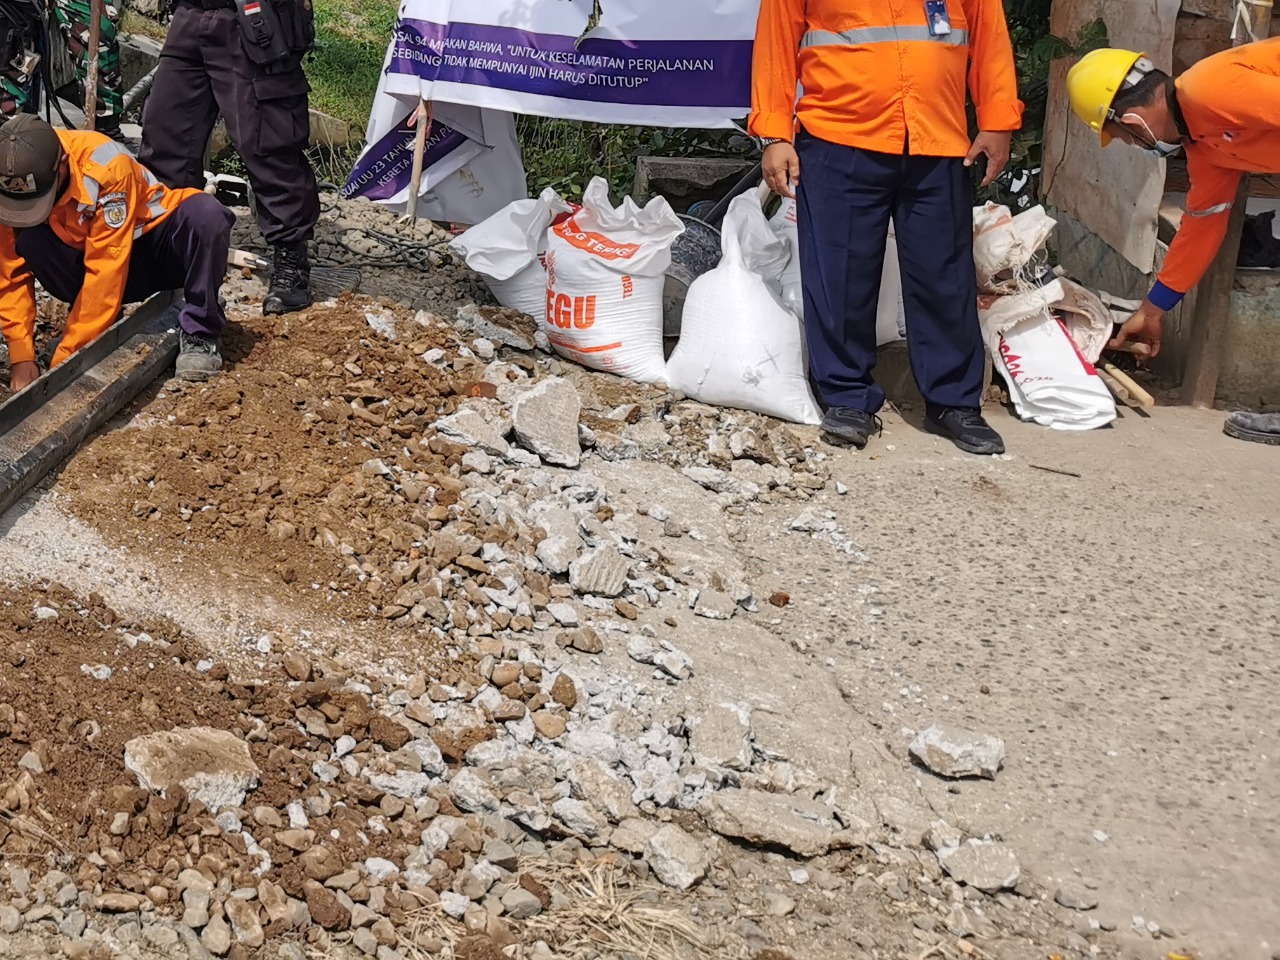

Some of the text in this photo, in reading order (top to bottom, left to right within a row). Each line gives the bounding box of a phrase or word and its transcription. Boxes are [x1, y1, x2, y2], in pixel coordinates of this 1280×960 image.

[444, 54, 467, 68] TIDAK
[469, 58, 528, 76] MEMPUNYAI
[529, 66, 547, 79] IJIN
[549, 69, 586, 84] HARUS
[549, 51, 625, 70] KESELAMATAN
[628, 59, 714, 73] PERJALANAN
[358, 170, 374, 187] UU
[371, 159, 386, 176] 23
[377, 157, 411, 188] KERETA
